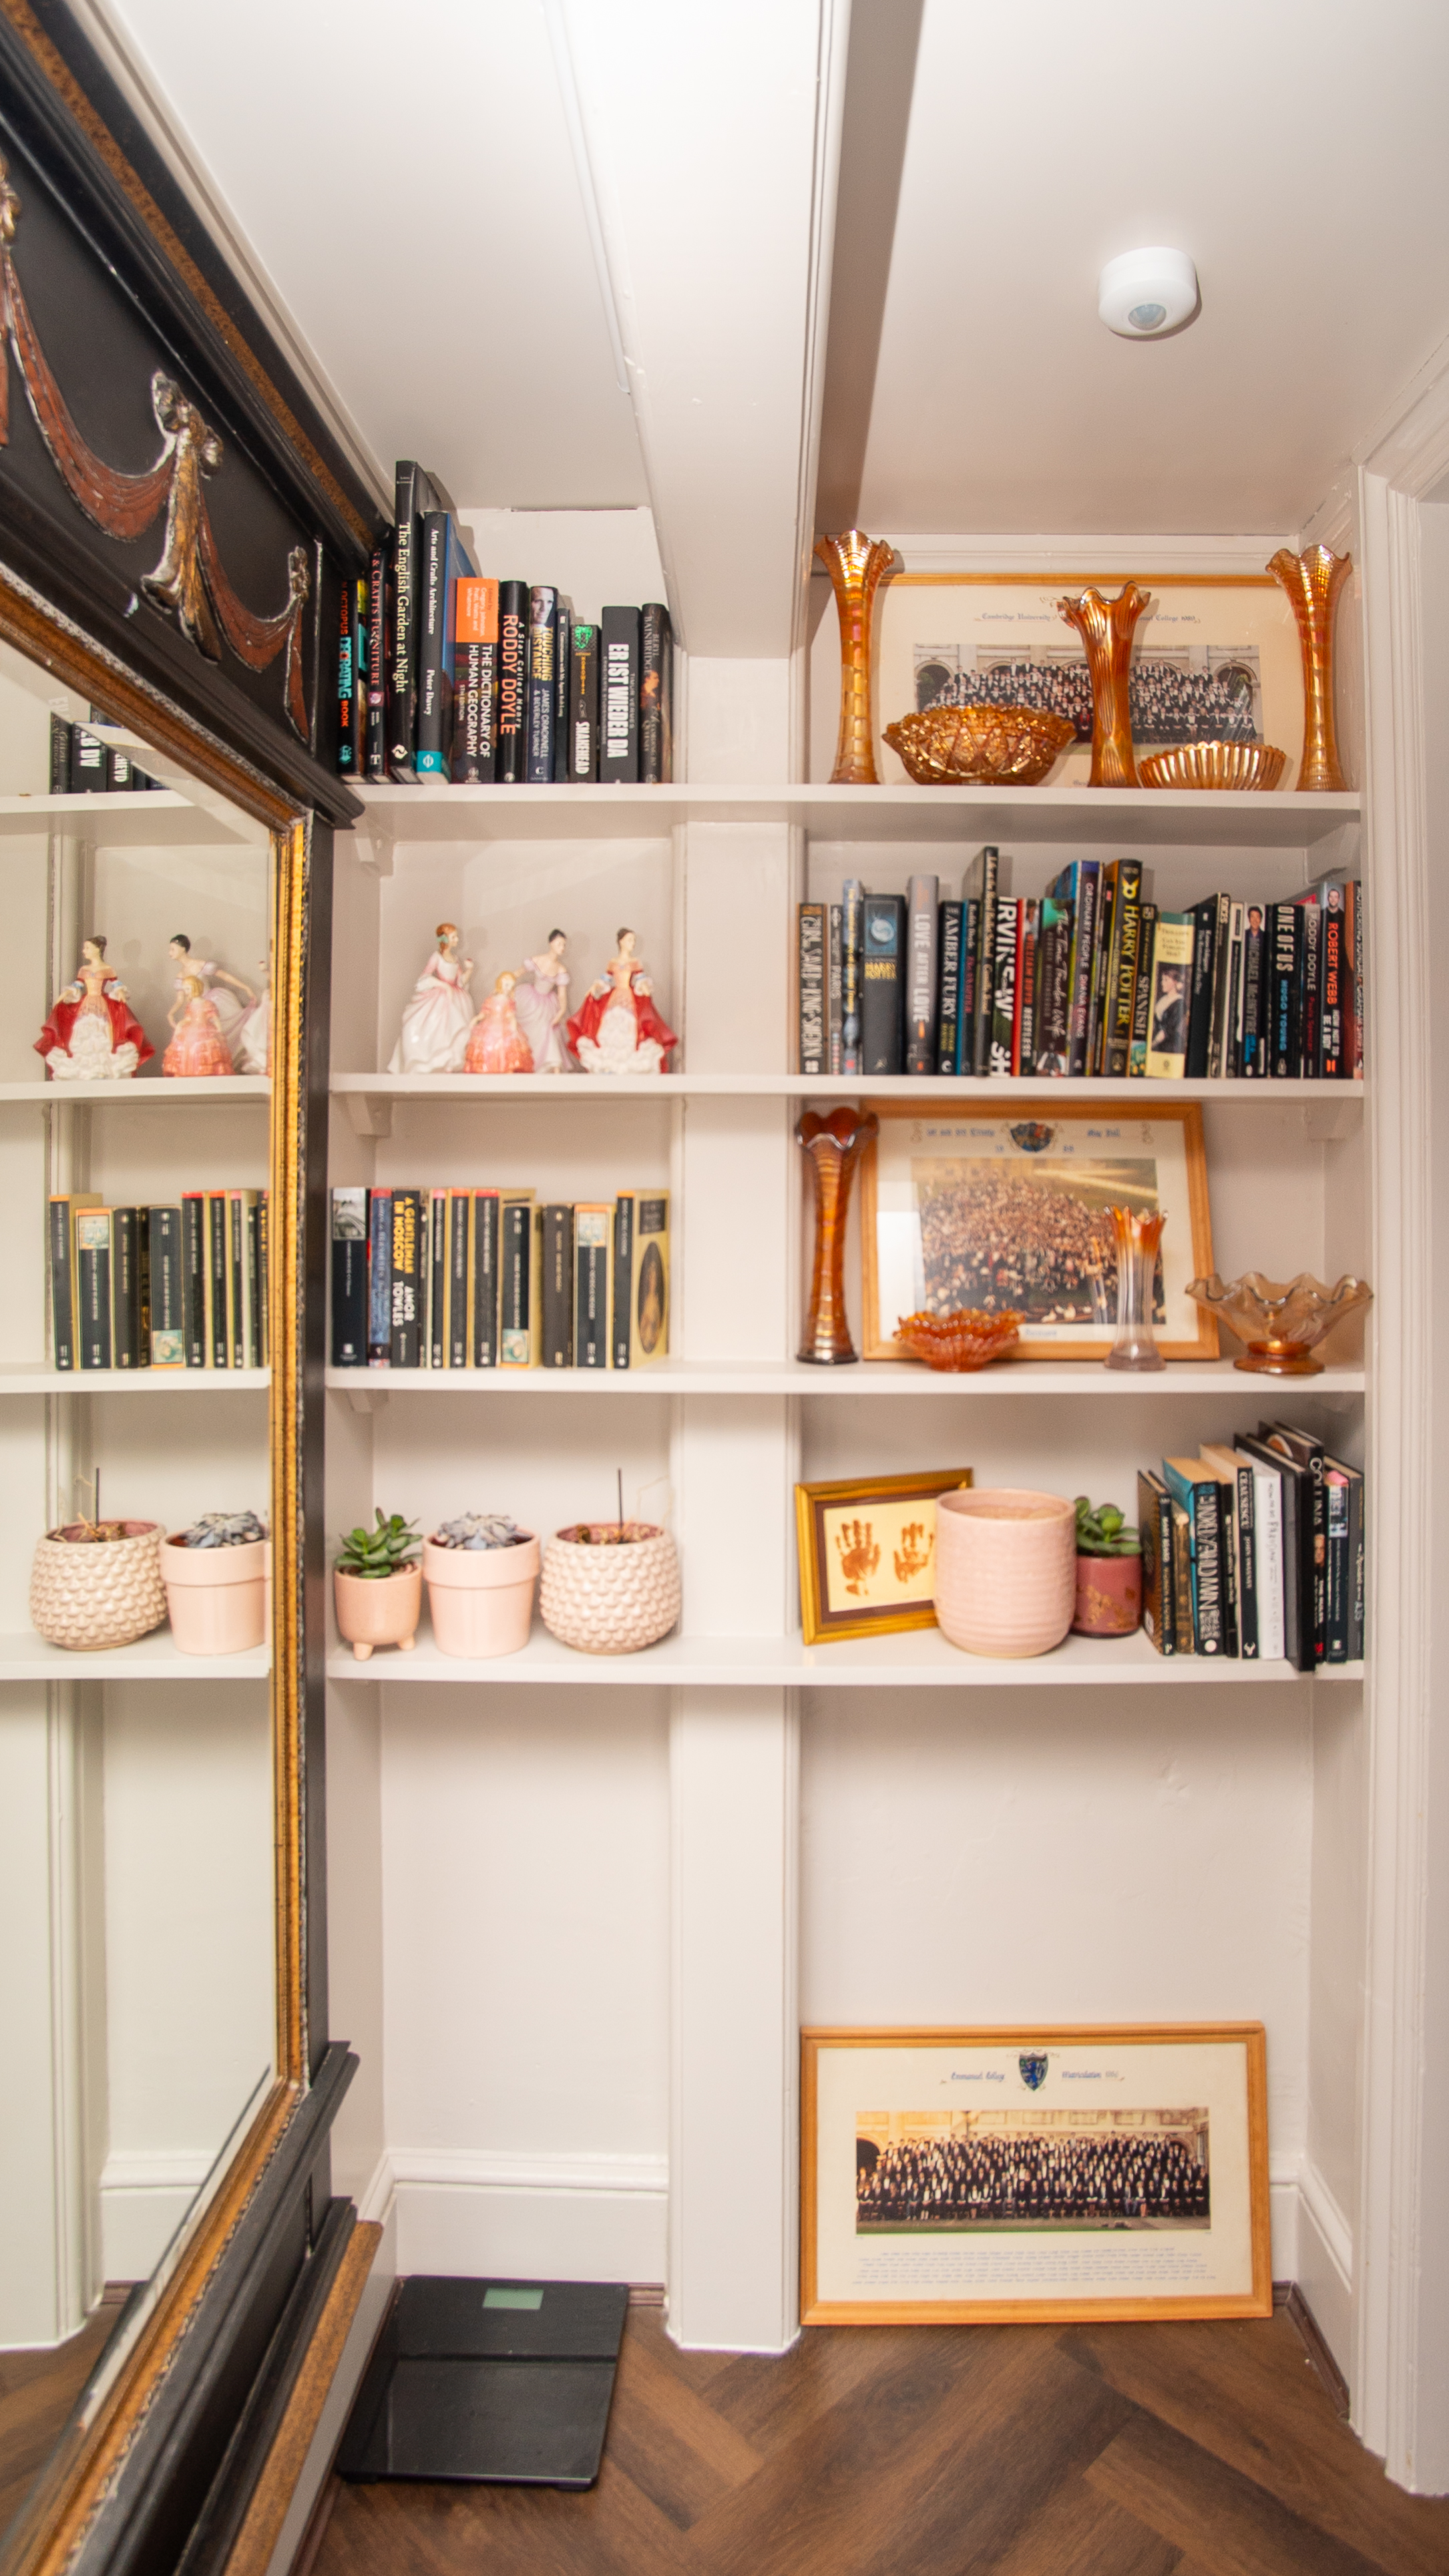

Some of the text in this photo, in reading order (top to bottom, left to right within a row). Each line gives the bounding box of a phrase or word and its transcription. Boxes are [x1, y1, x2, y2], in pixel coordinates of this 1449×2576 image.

[371, 570, 382, 614] CRAFTS
[393, 522, 411, 693] The English Garden at Night
[428, 529, 440, 634] Arts and Crafts Architecture
[982, 612, 1050, 622] Cambridge University
[1156, 614, 1178, 623] College
[371, 618, 381, 685] FURNITURE
[532, 627, 542, 680] DISTANCE
[542, 626, 553, 681] TOUCHING
[644, 616, 652, 676] BAINBRIDGE
[424, 670, 435, 716] Peter Davey
[466, 644, 479, 757] HUMAN GEOGRAPHY
[480, 644, 492, 758] THE DICTIONARY OF
[500, 615, 518, 734] RODDY DOYLE
[516, 660, 524, 694] Called
[607, 644, 629, 758] ER IST WIEDER DA
[341, 700, 349, 727] BOOK
[515, 698, 523, 729] Henry
[540, 688, 550, 759] JAMES CRACKNELL
[575, 721, 590, 775] SNAKEHEAD
[1055, 909, 1069, 935] The
[1080, 883, 1094, 968] ORDINARY PEOPLE
[1120, 905, 1139, 959] HARRY
[1219, 897, 1229, 924] VOICES
[1276, 905, 1294, 972] ONE OF US
[1307, 913, 1317, 991] RODDY DOYLE
[1327, 922, 1339, 1004] ROBERT WEBB
[831, 965, 841, 1000] PARIS
[913, 913, 931, 1023] LOVE AFTER LOVE
[942, 915, 959, 1019] AMBER FURY
[1116, 964, 1134, 1026] POTTER
[1134, 976, 1149, 1035] SPANISH
[1323, 1015, 1331, 1026] BE
[1022, 1007, 1033, 1058] RESTLESS
[1043, 1009, 1066, 1038] Wife
[1322, 1033, 1331, 1050] BOY
[1331, 1046, 1339, 1056] TO
[393, 1201, 404, 1271] IN MOSCOW
[404, 1197, 415, 1274] A GENTLEMAN
[393, 1281, 404, 1327] TOWLES
[404, 1286, 414, 1321] AMOR
